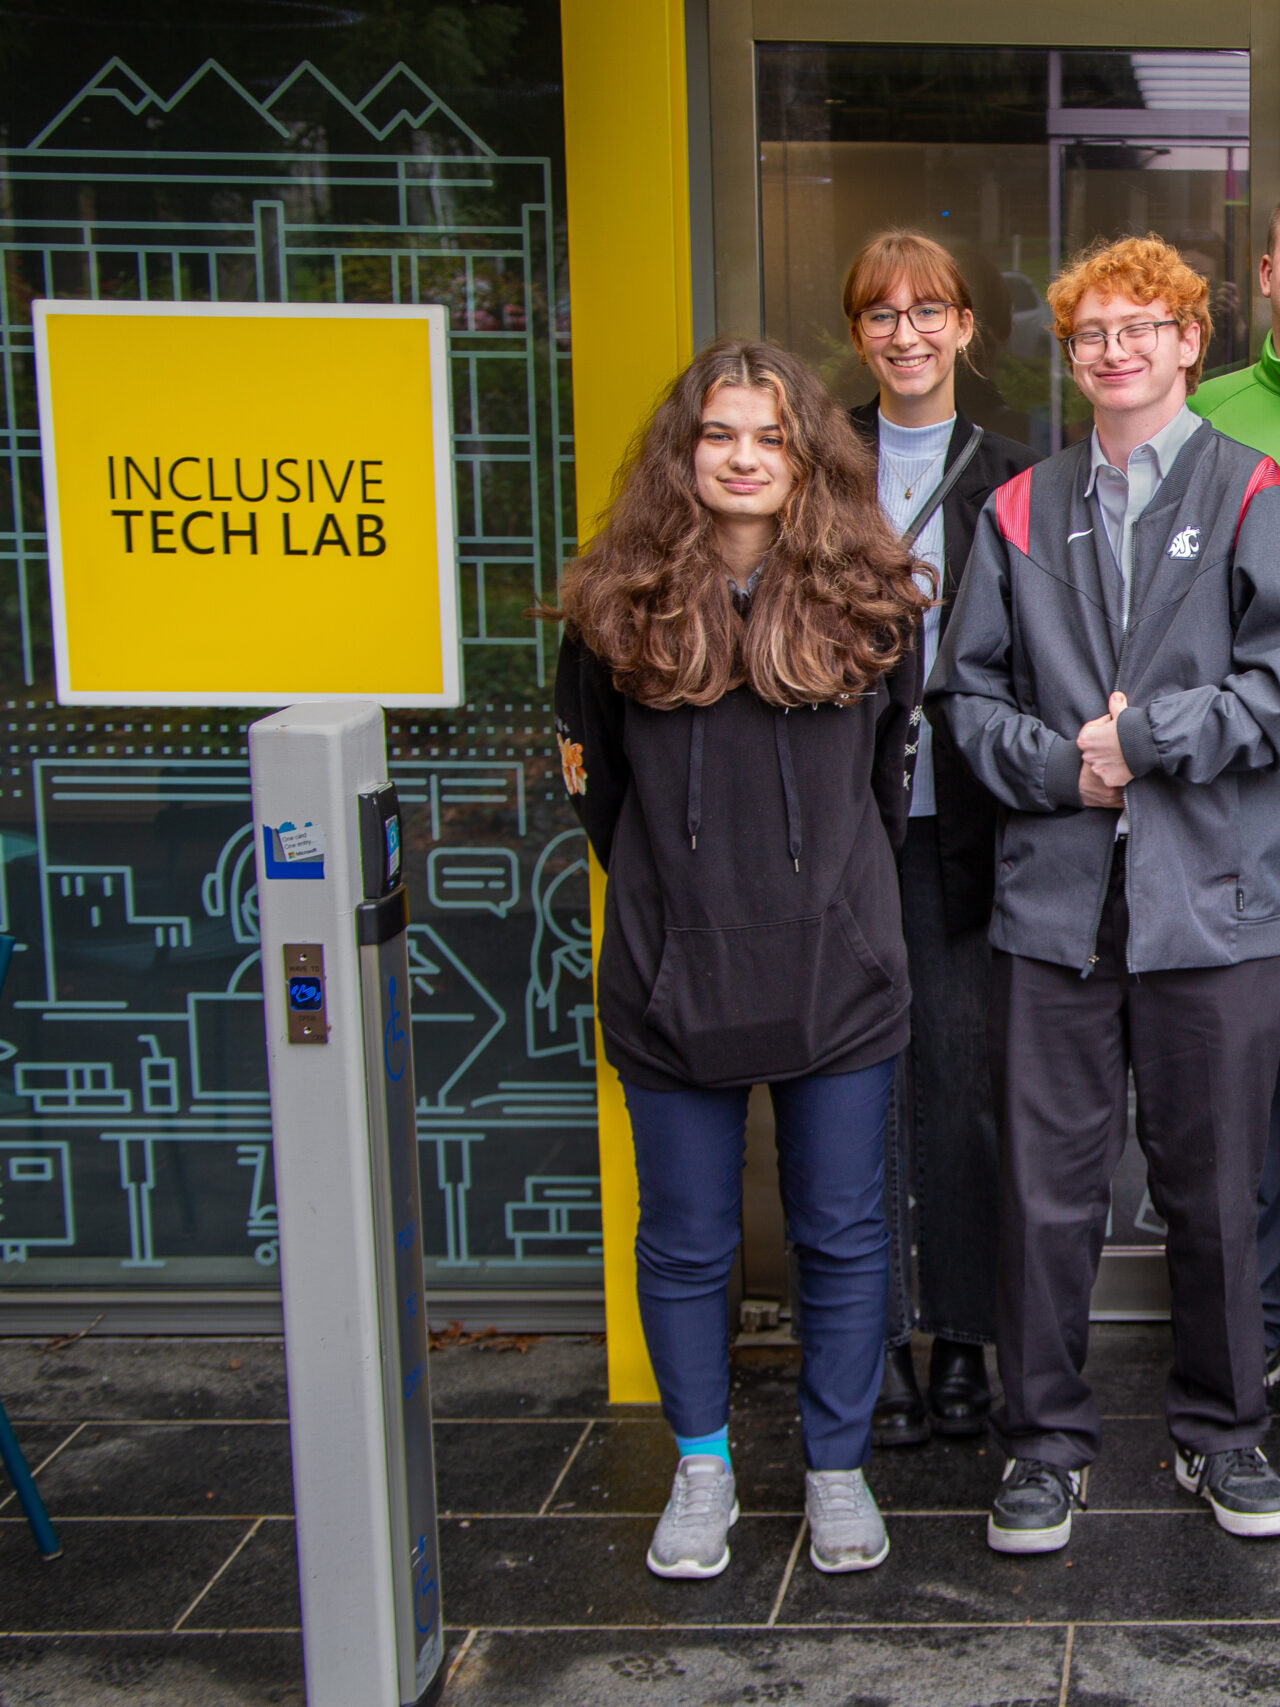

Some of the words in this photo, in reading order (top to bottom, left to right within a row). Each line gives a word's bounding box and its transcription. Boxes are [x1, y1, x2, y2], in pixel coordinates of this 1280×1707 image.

[107, 455, 387, 504] INCLUSIVE
[111, 510, 259, 556] TECH
[281, 513, 387, 557] LAB
